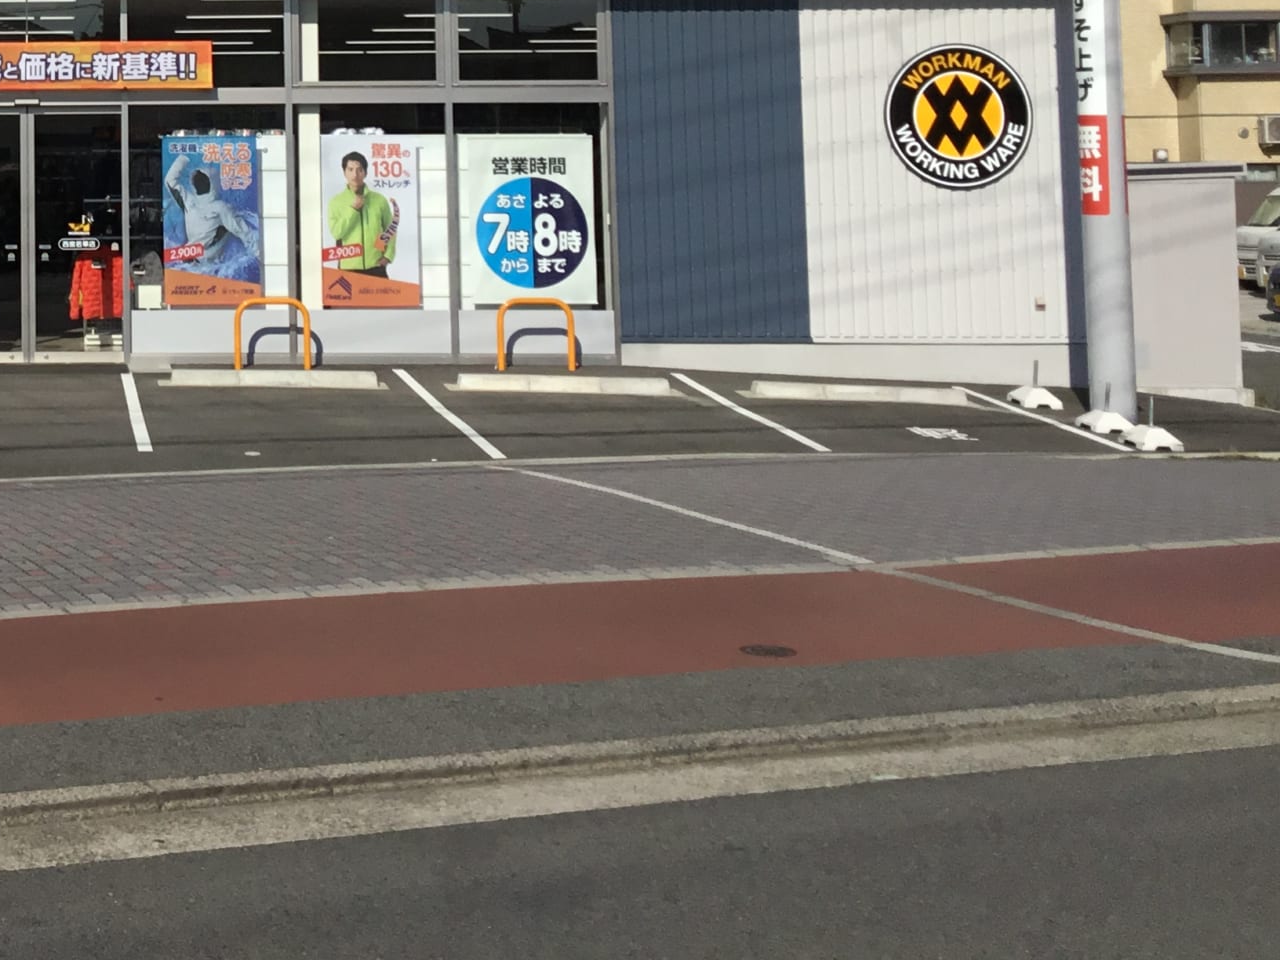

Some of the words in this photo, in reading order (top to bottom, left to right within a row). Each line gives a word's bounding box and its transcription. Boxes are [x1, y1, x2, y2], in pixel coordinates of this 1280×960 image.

[902, 52, 1011, 90] WORKMAN
[371, 142, 411, 159] 驚異の
[896, 123, 980, 180] WORKING
[980, 122, 1025, 172] WARE
[491, 157, 567, 176] 営業時間
[373, 179, 411, 189] ストレッチ
[496, 194, 527, 208] あさ
[533, 193, 565, 208] よる
[482, 212, 530, 254] 7時
[533, 212, 583, 257] 8時
[500, 259, 529, 273] から
[537, 258, 567, 273] まで
